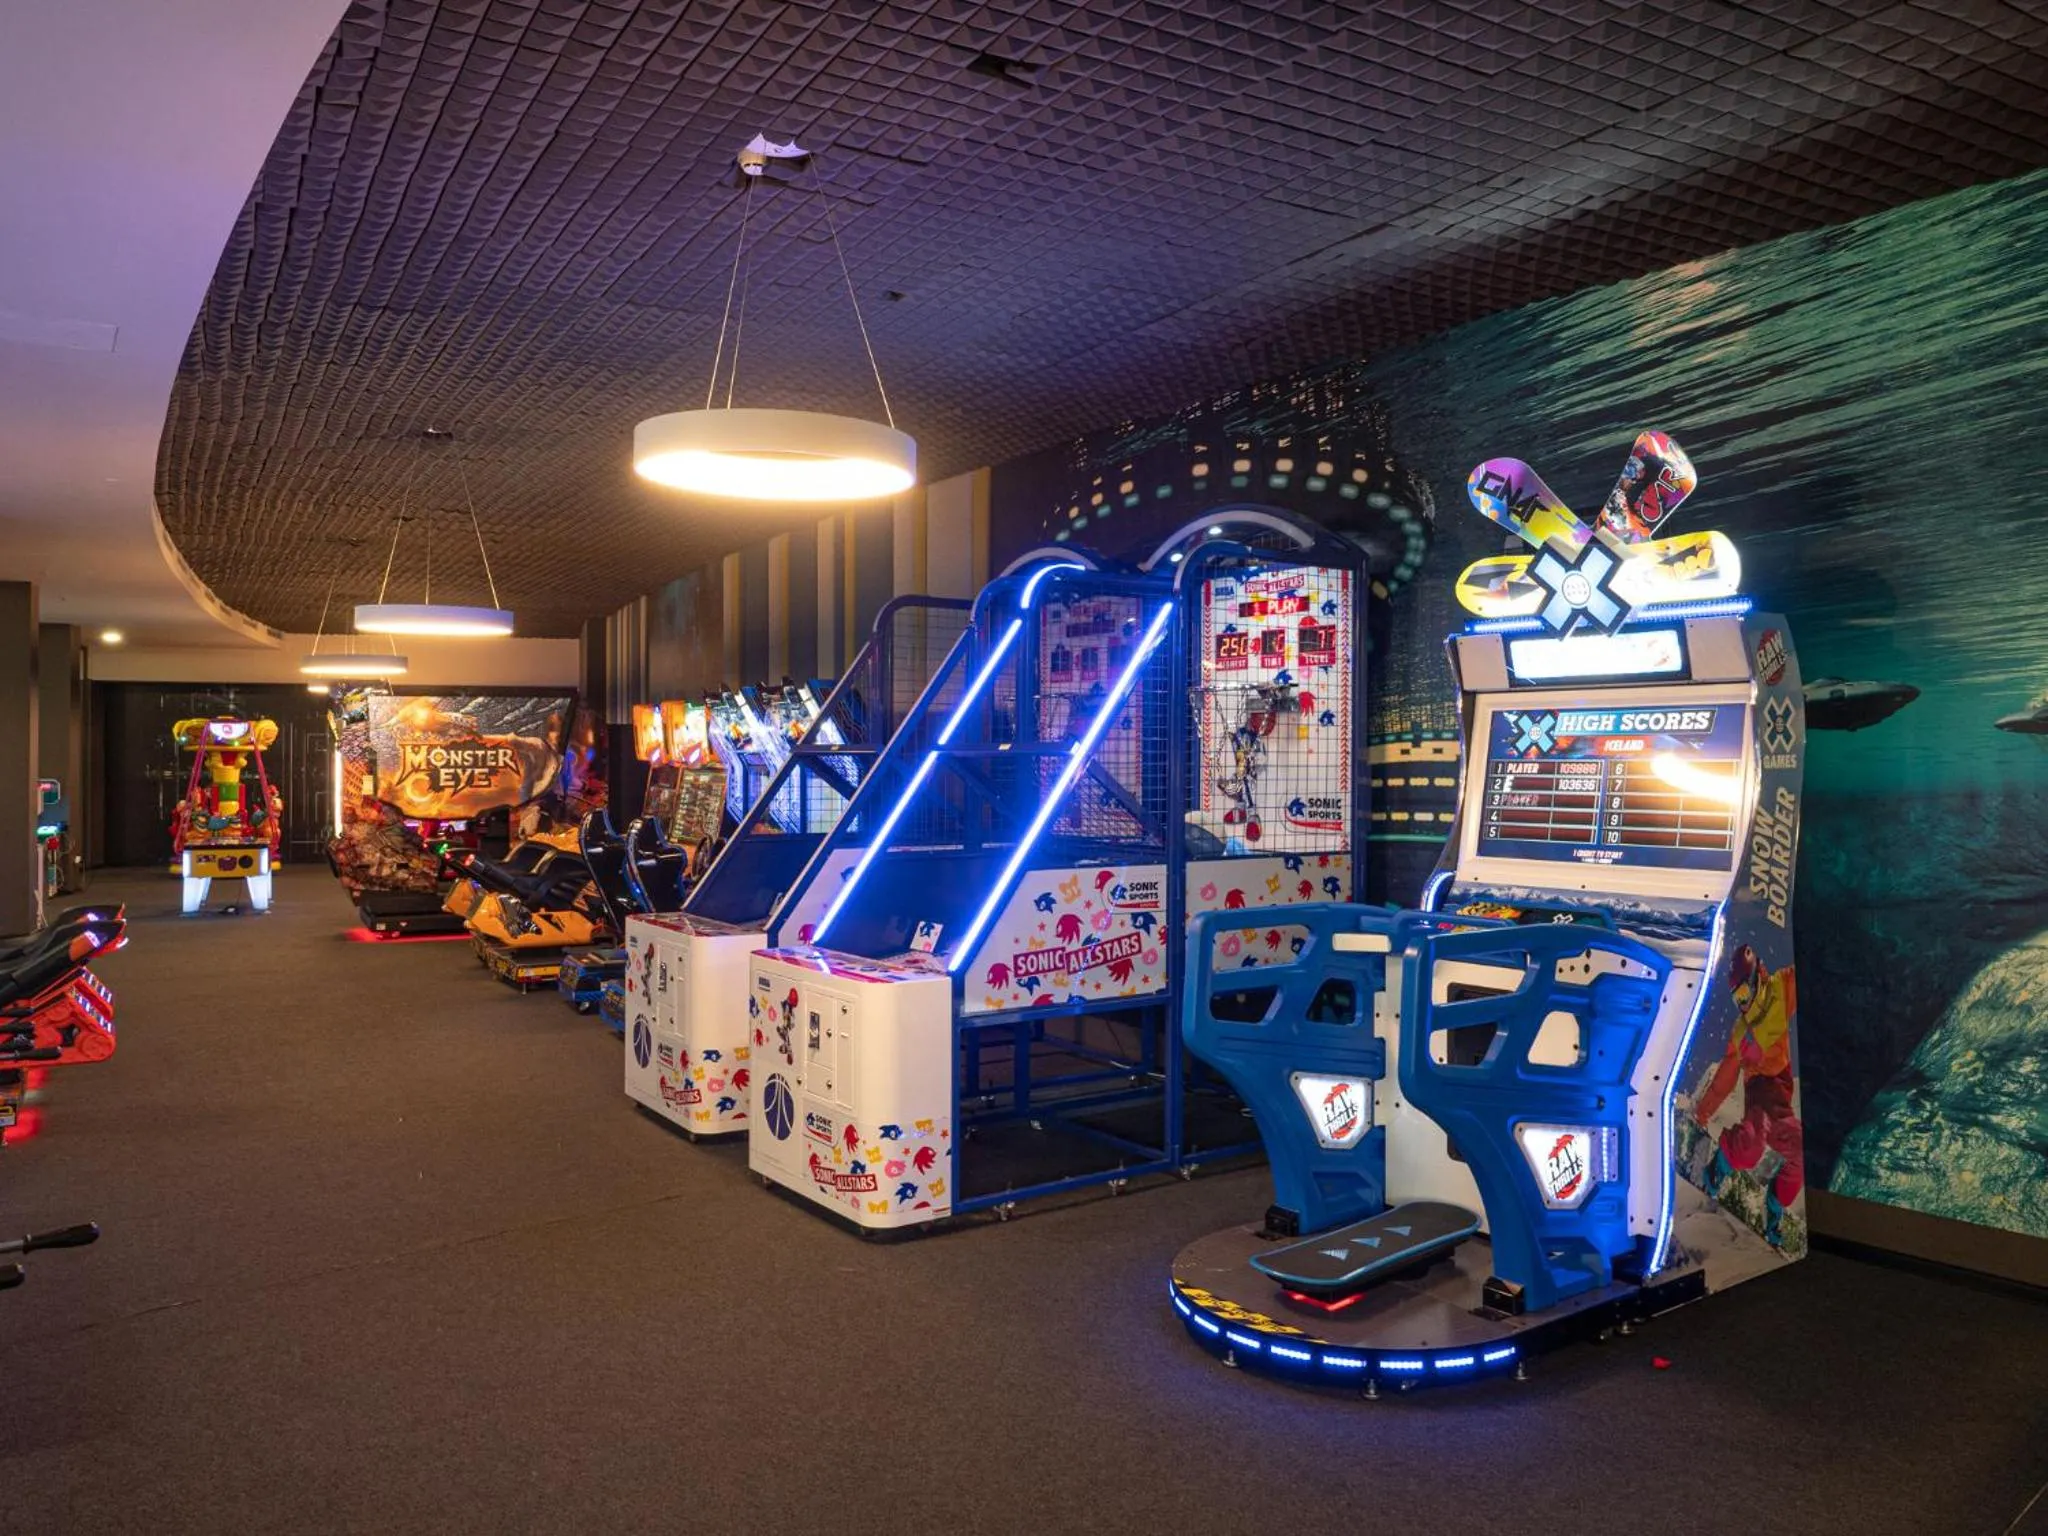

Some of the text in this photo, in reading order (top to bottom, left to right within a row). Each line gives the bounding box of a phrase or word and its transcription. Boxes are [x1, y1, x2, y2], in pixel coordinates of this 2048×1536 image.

[1268, 600, 1299, 613] PLAY
[1561, 711, 1710, 732] HIGH SCORES
[1604, 739, 1645, 751] ICELAND
[396, 744, 521, 786] MONSTER
[1763, 754, 1797, 769] GAMES
[1507, 763, 1539, 774] PLAYER
[1615, 764, 1622, 775] 6
[439, 767, 490, 796] EYE
[1494, 779, 1501, 790] 2
[1615, 780, 1622, 791] 7
[1308, 798, 1342, 809] SONIC
[1492, 795, 1500, 806] 3
[1612, 797, 1620, 808] 8
[1308, 811, 1342, 820] SPORTS
[1490, 811, 1497, 821] 4
[1610, 815, 1619, 826] 9
[1489, 827, 1496, 838] 5
[1607, 831, 1619, 843] 10
[1751, 805, 1774, 899] SNOW
[1767, 786, 1795, 928] BOARDER
[1129, 882, 1159, 892] SONIC
[1129, 892, 1159, 901] SPORTS
[1016, 950, 1065, 974] SONIC
[815, 1168, 836, 1184] SONIC
